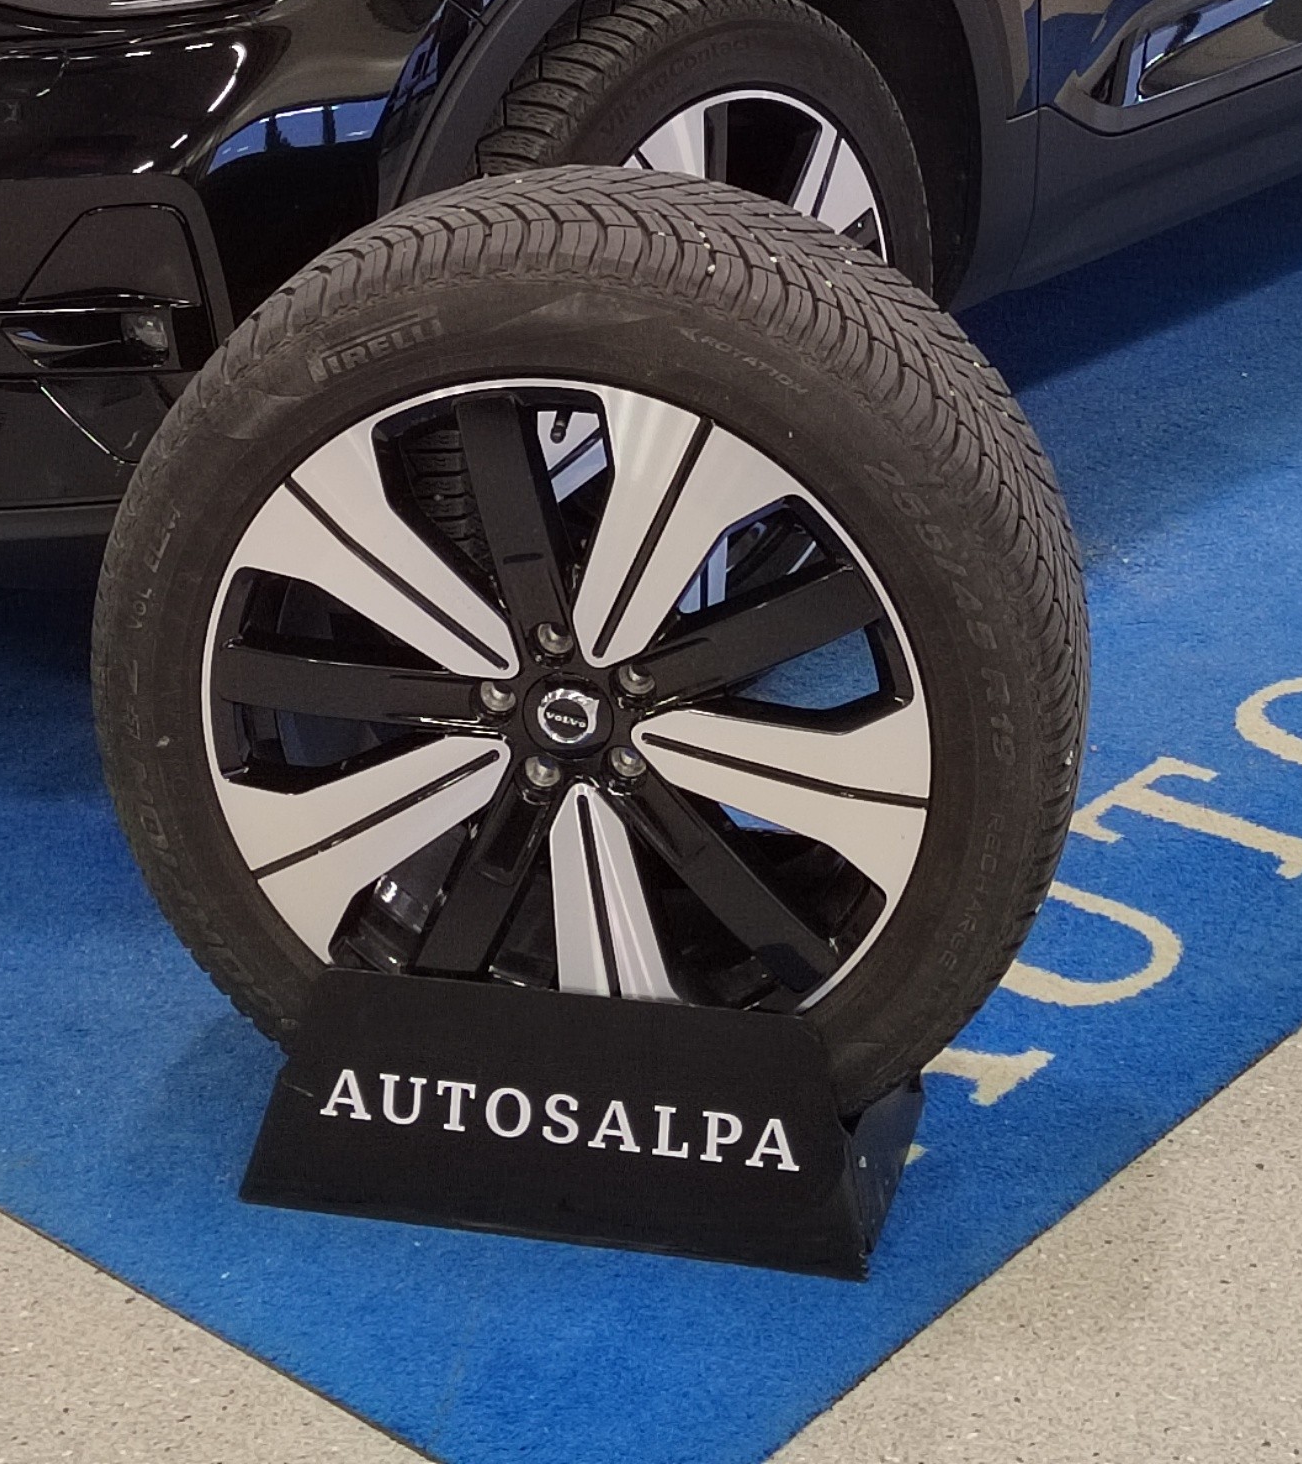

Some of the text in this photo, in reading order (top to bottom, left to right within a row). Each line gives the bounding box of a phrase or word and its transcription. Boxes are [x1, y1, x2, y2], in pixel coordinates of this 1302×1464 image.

[303, 303, 444, 384] PIRELLI
[545, 711, 587, 728] VOLVO
[319, 1068, 801, 1172] AUTOSALPA
